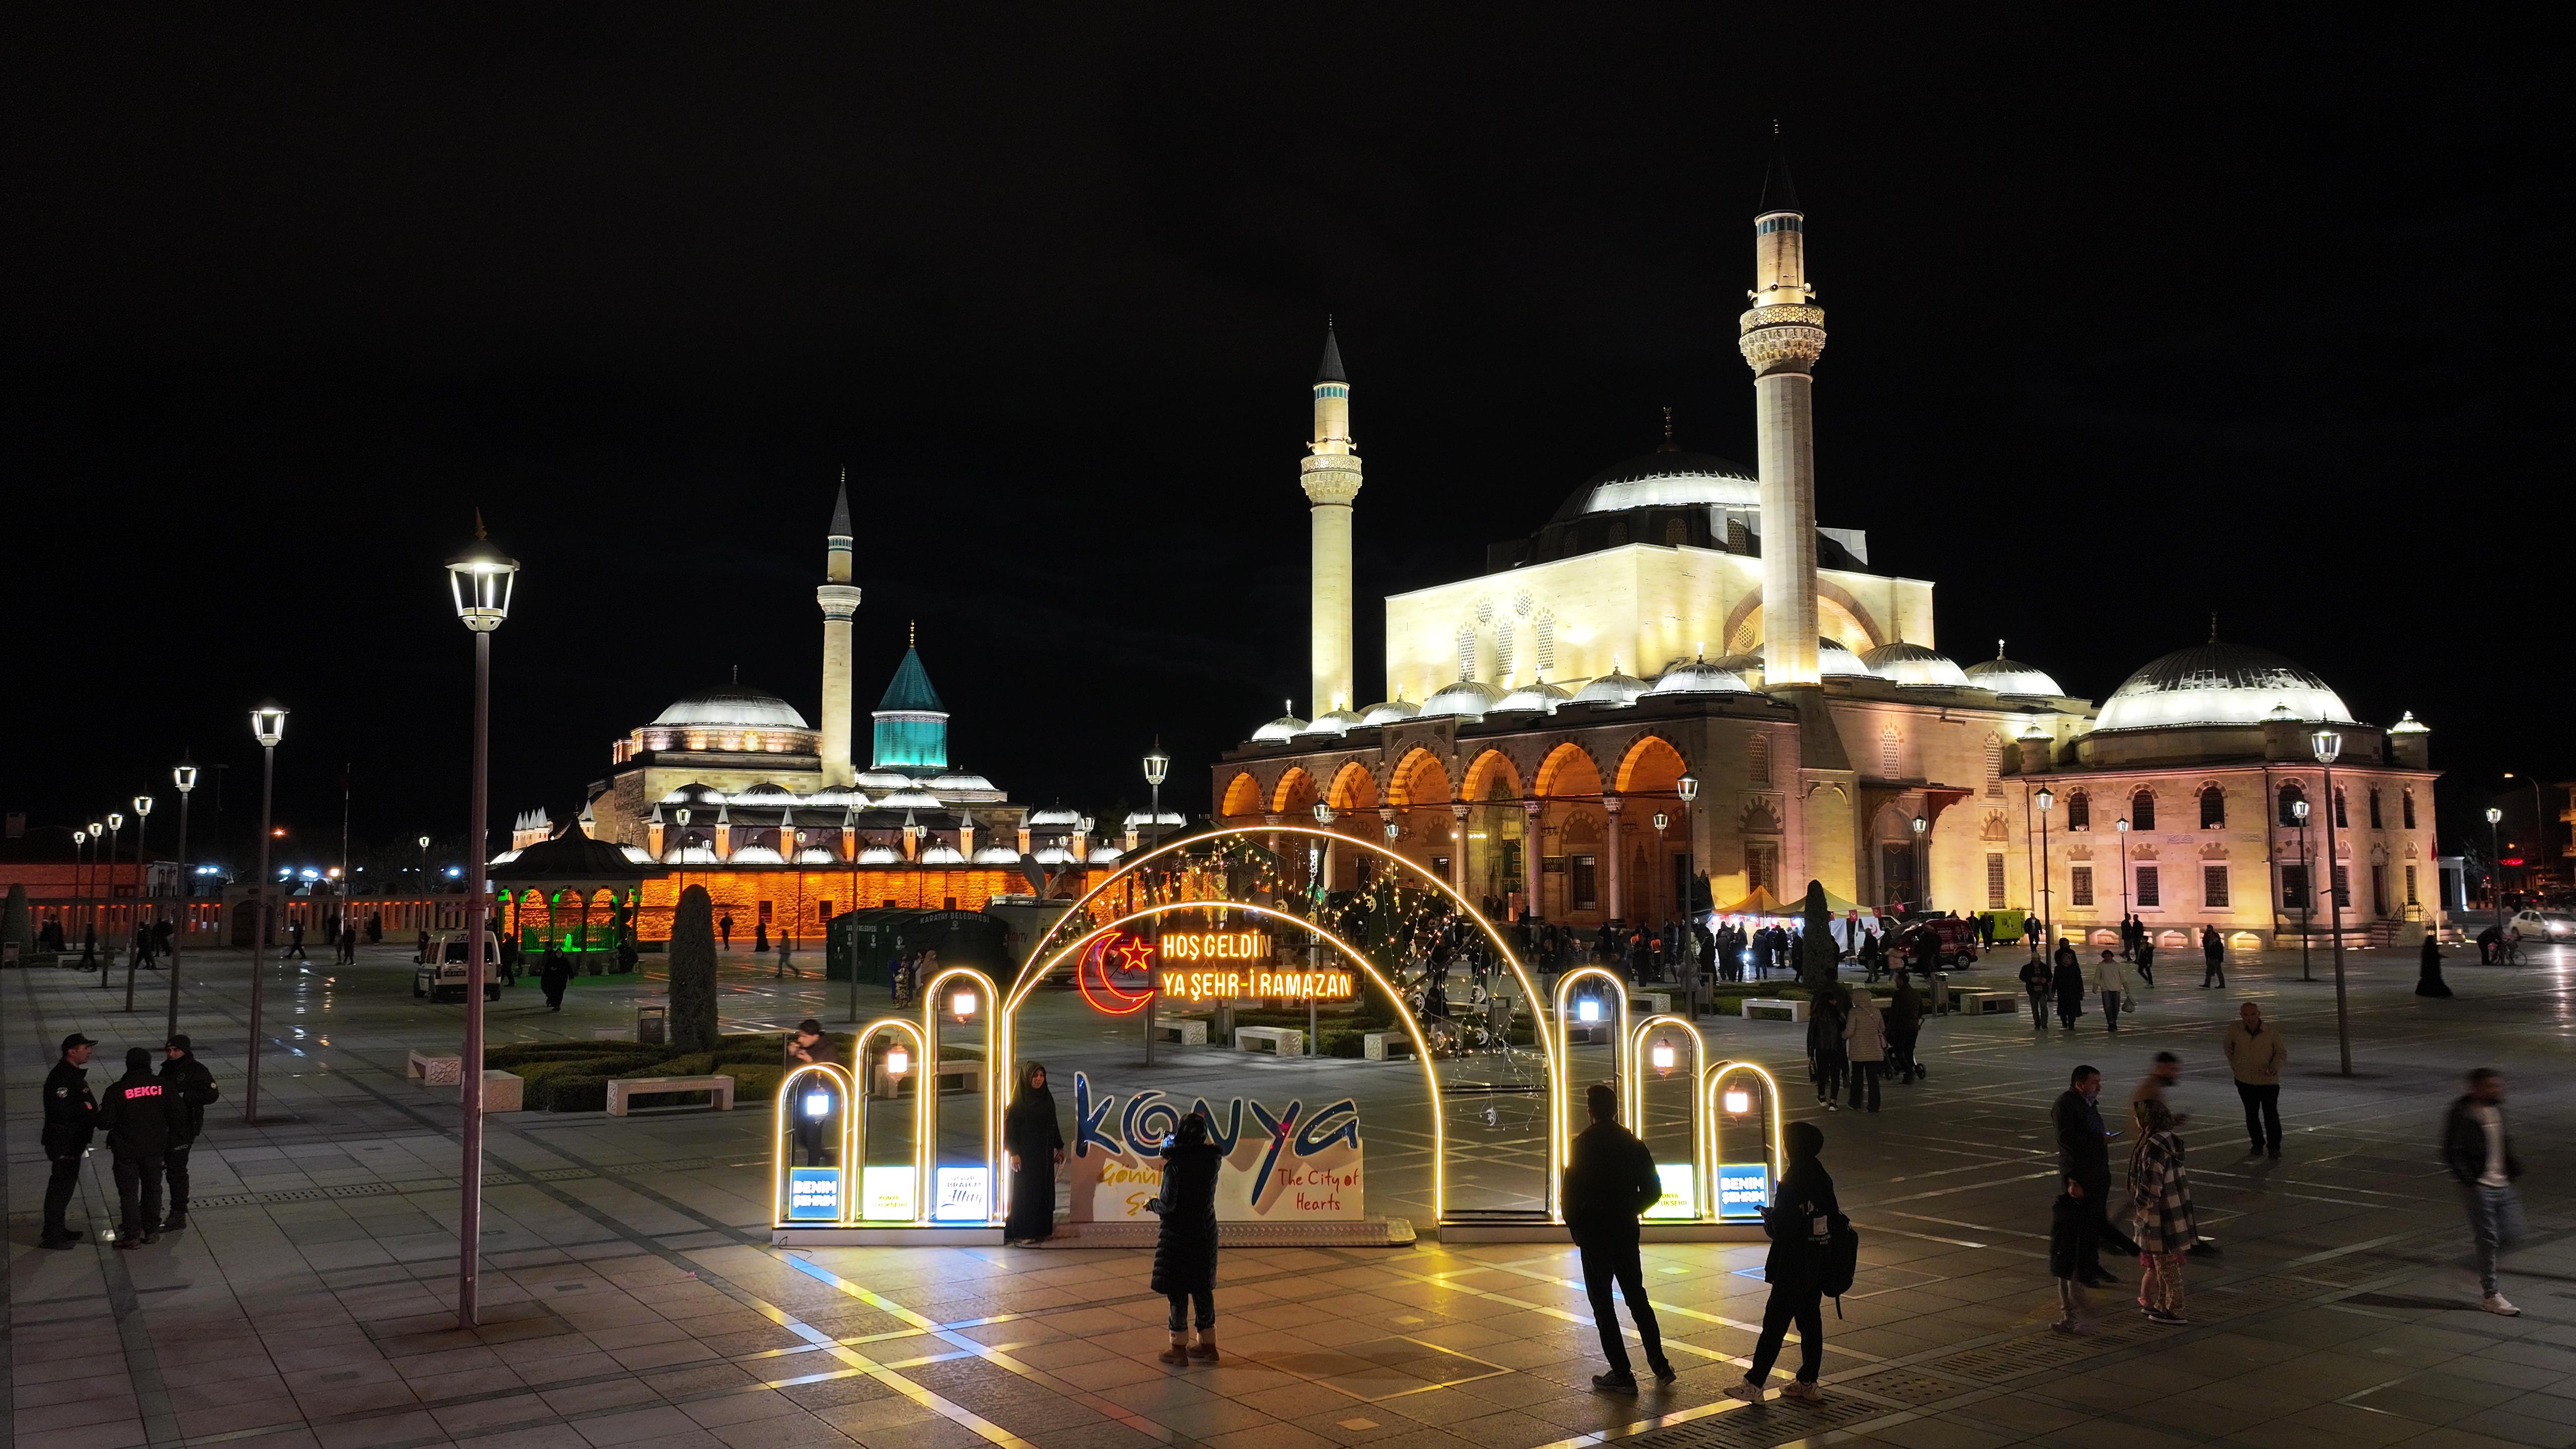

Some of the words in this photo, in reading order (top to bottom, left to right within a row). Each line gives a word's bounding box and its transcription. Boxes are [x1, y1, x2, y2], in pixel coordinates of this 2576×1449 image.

[920, 912, 948, 924] KARATAY
[950, 912, 990, 924] BELEDİYESİ
[1163, 934, 1200, 960] HOŞ
[1204, 930, 1271, 958] GELDİN
[1163, 973, 1185, 996] YA
[1260, 973, 1351, 997] RAMAZAN
[1278, 1169, 1303, 1186] The
[1308, 1168, 1339, 1193] City
[1344, 1168, 1359, 1186] of
[1297, 1192, 1341, 1211] Hearts
